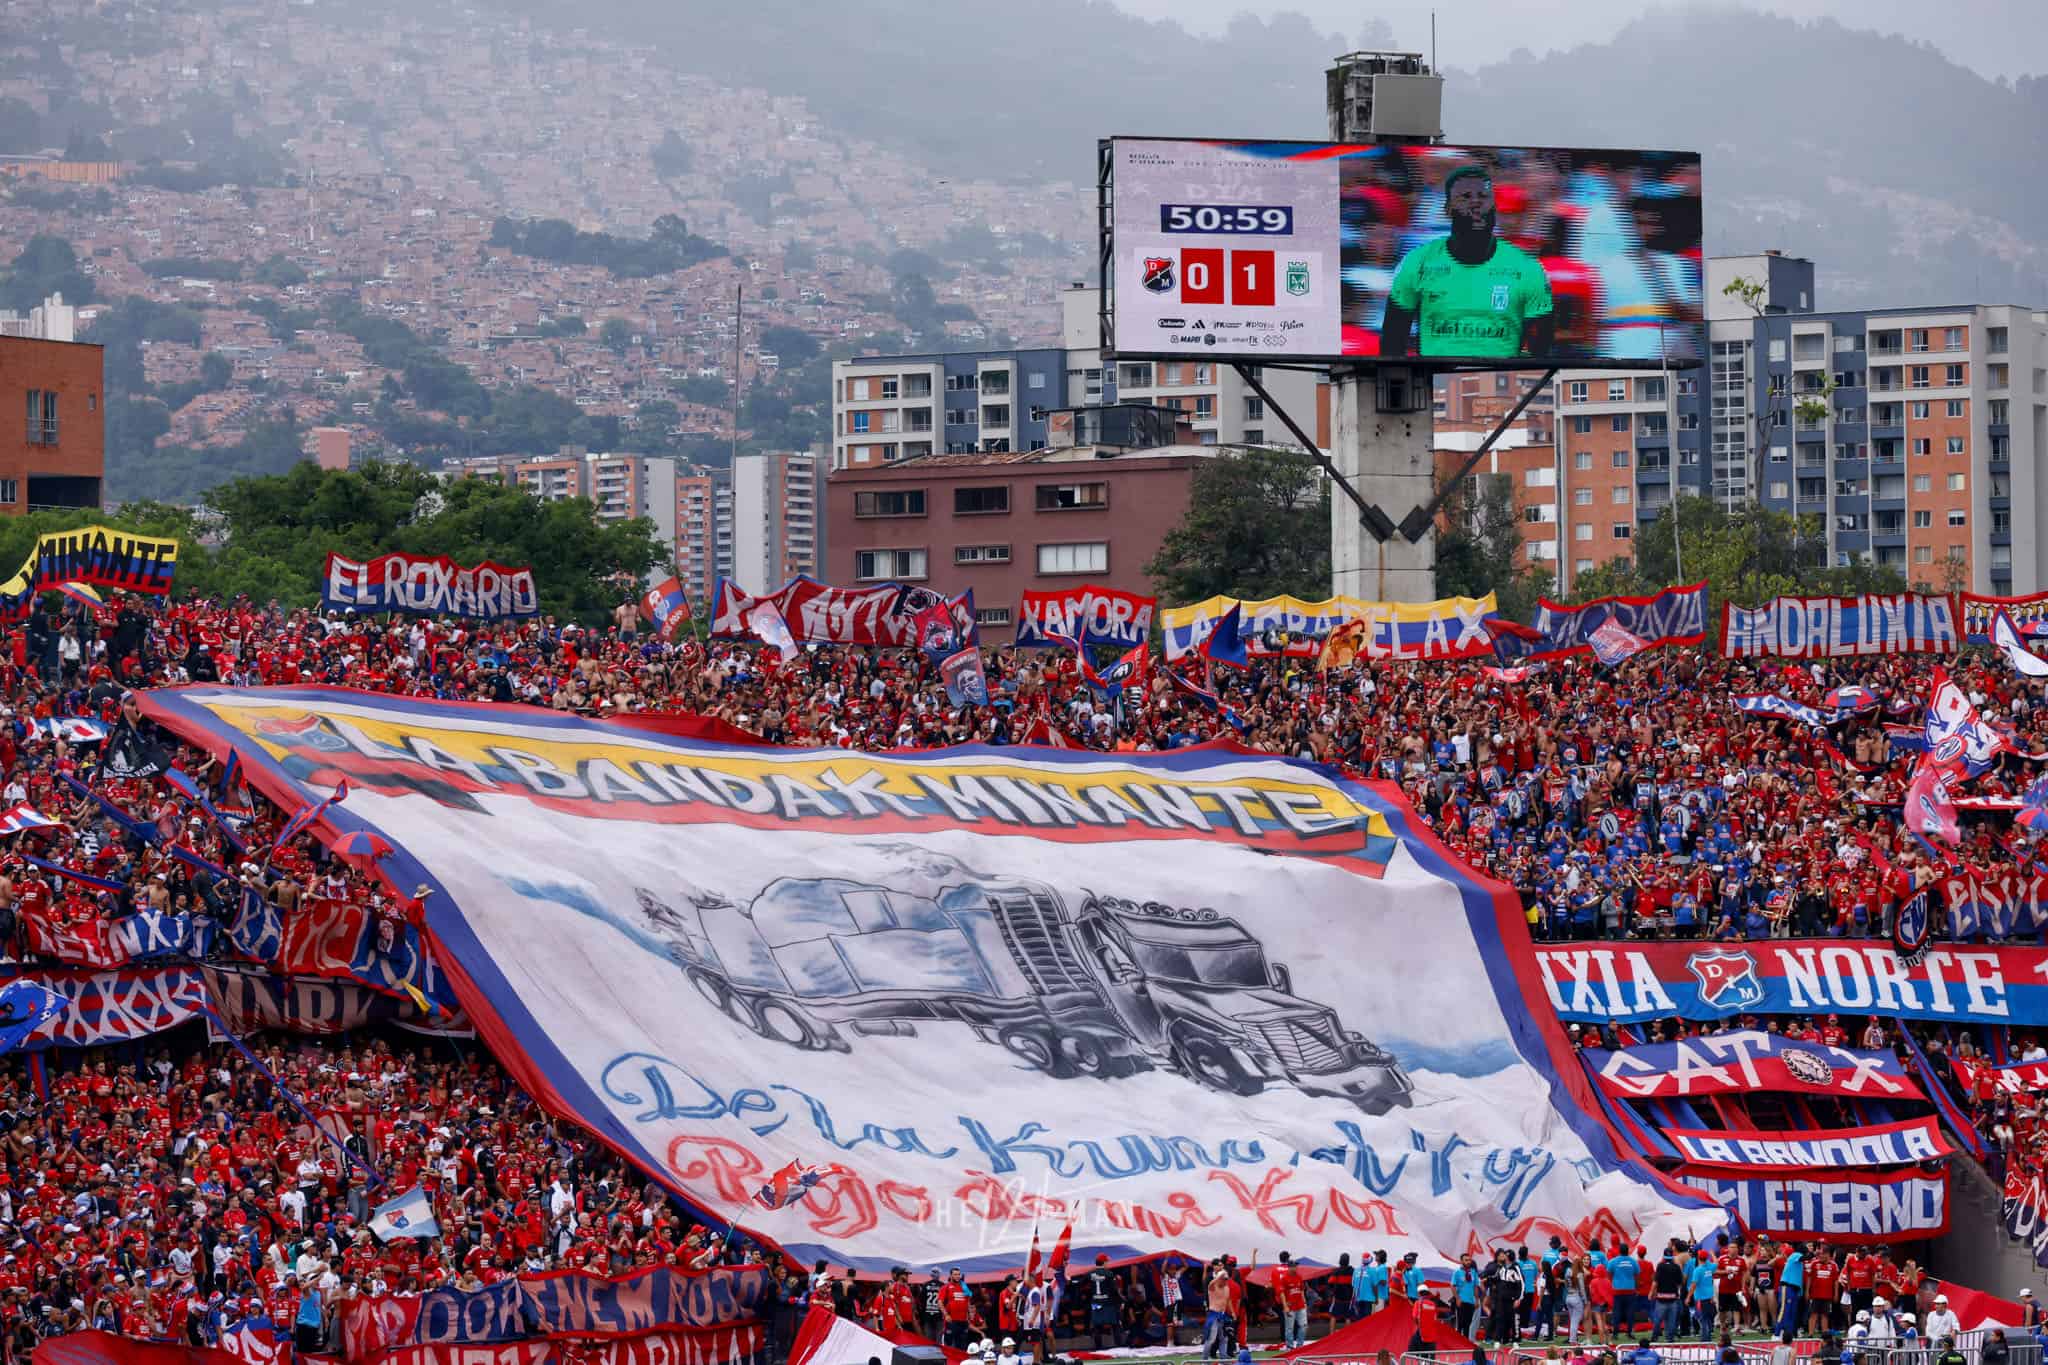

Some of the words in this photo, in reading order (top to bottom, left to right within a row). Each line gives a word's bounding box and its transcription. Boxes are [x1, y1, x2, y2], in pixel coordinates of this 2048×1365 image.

[1169, 207, 1288, 232] 50:59
[1188, 262, 1209, 290] 0
[1243, 263, 1257, 290] 1
[328, 555, 371, 604] EL
[383, 557, 538, 618] ROXARIO
[1018, 589, 1154, 643] XAMORA
[319, 713, 502, 790] LA
[494, 747, 843, 820] BANDA
[1774, 947, 2010, 1016] NORTE
[1765, 1178, 1945, 1235] ETERNO
